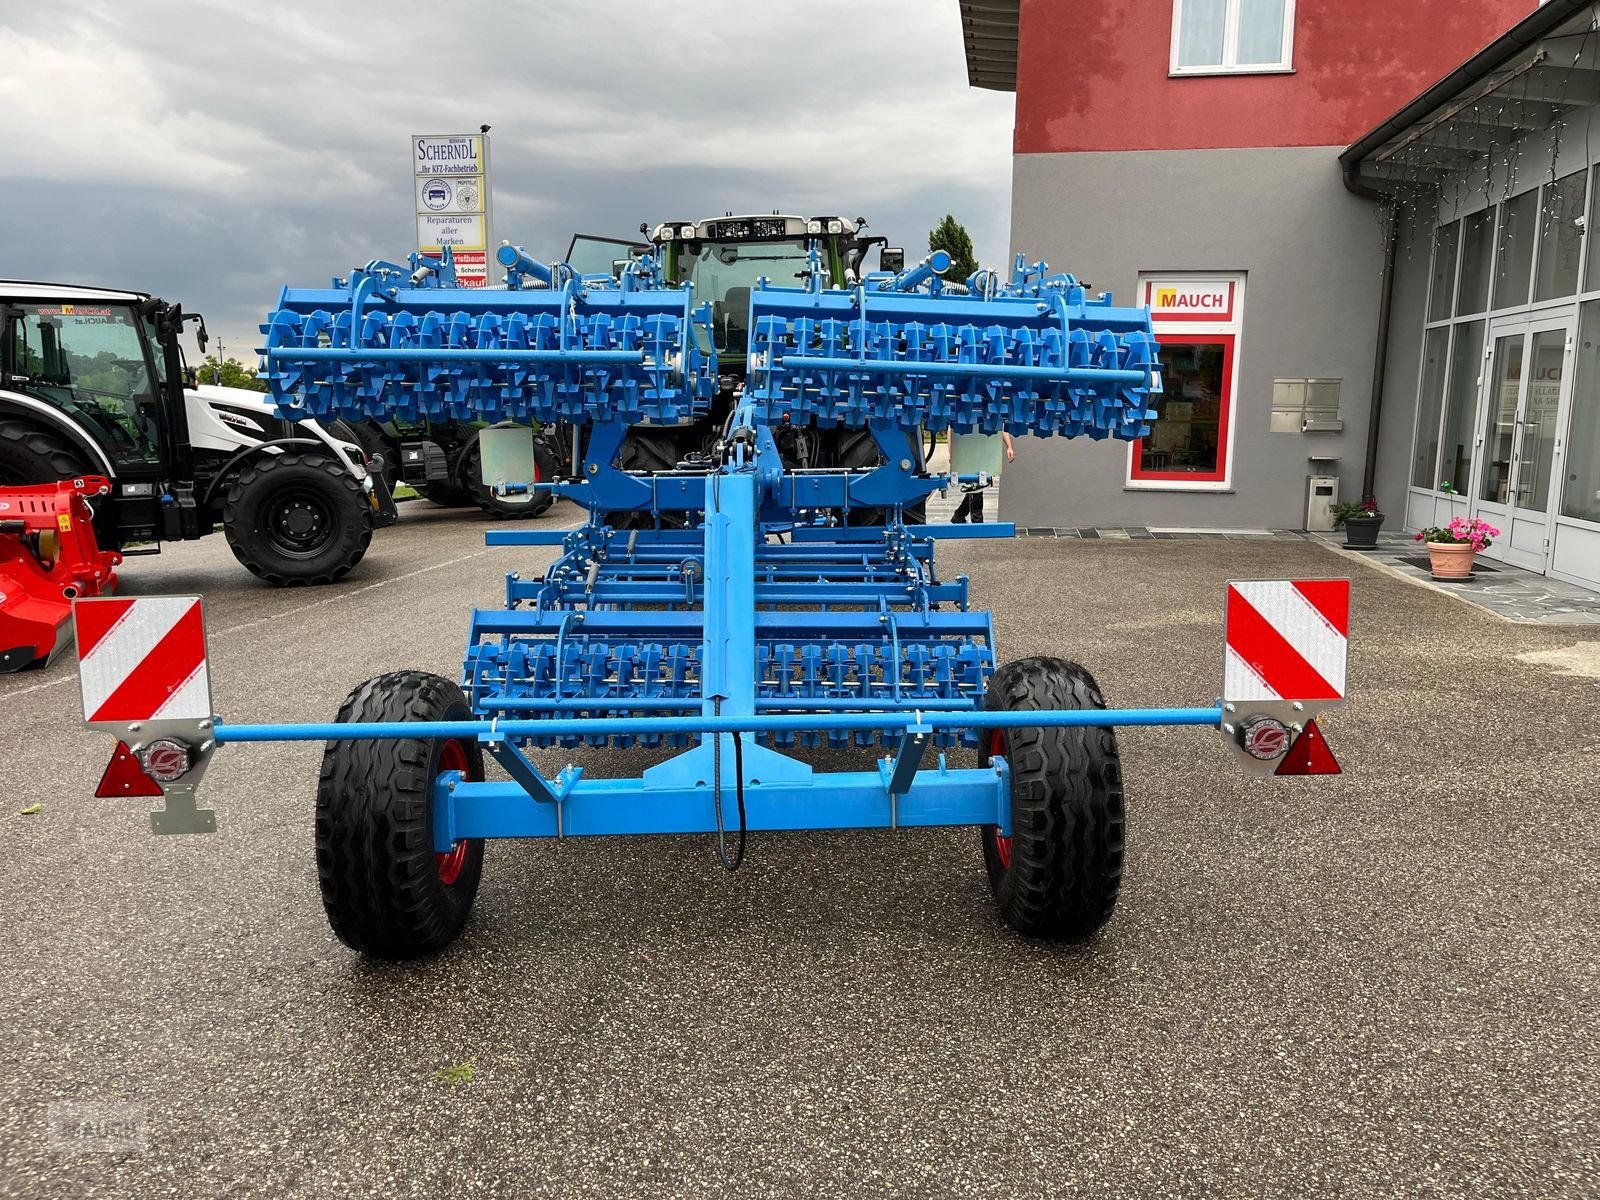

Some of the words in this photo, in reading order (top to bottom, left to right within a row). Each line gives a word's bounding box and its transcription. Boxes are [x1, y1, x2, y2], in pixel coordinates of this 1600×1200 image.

[418, 139, 477, 160] SCHERNDL
[432, 164, 478, 173] KFZ-Fachbetrieb
[427, 216, 472, 225] Reparaturen
[436, 237, 464, 245] Marken
[453, 254, 485, 263] ristbaum
[1162, 294, 1223, 308] MAUCH
